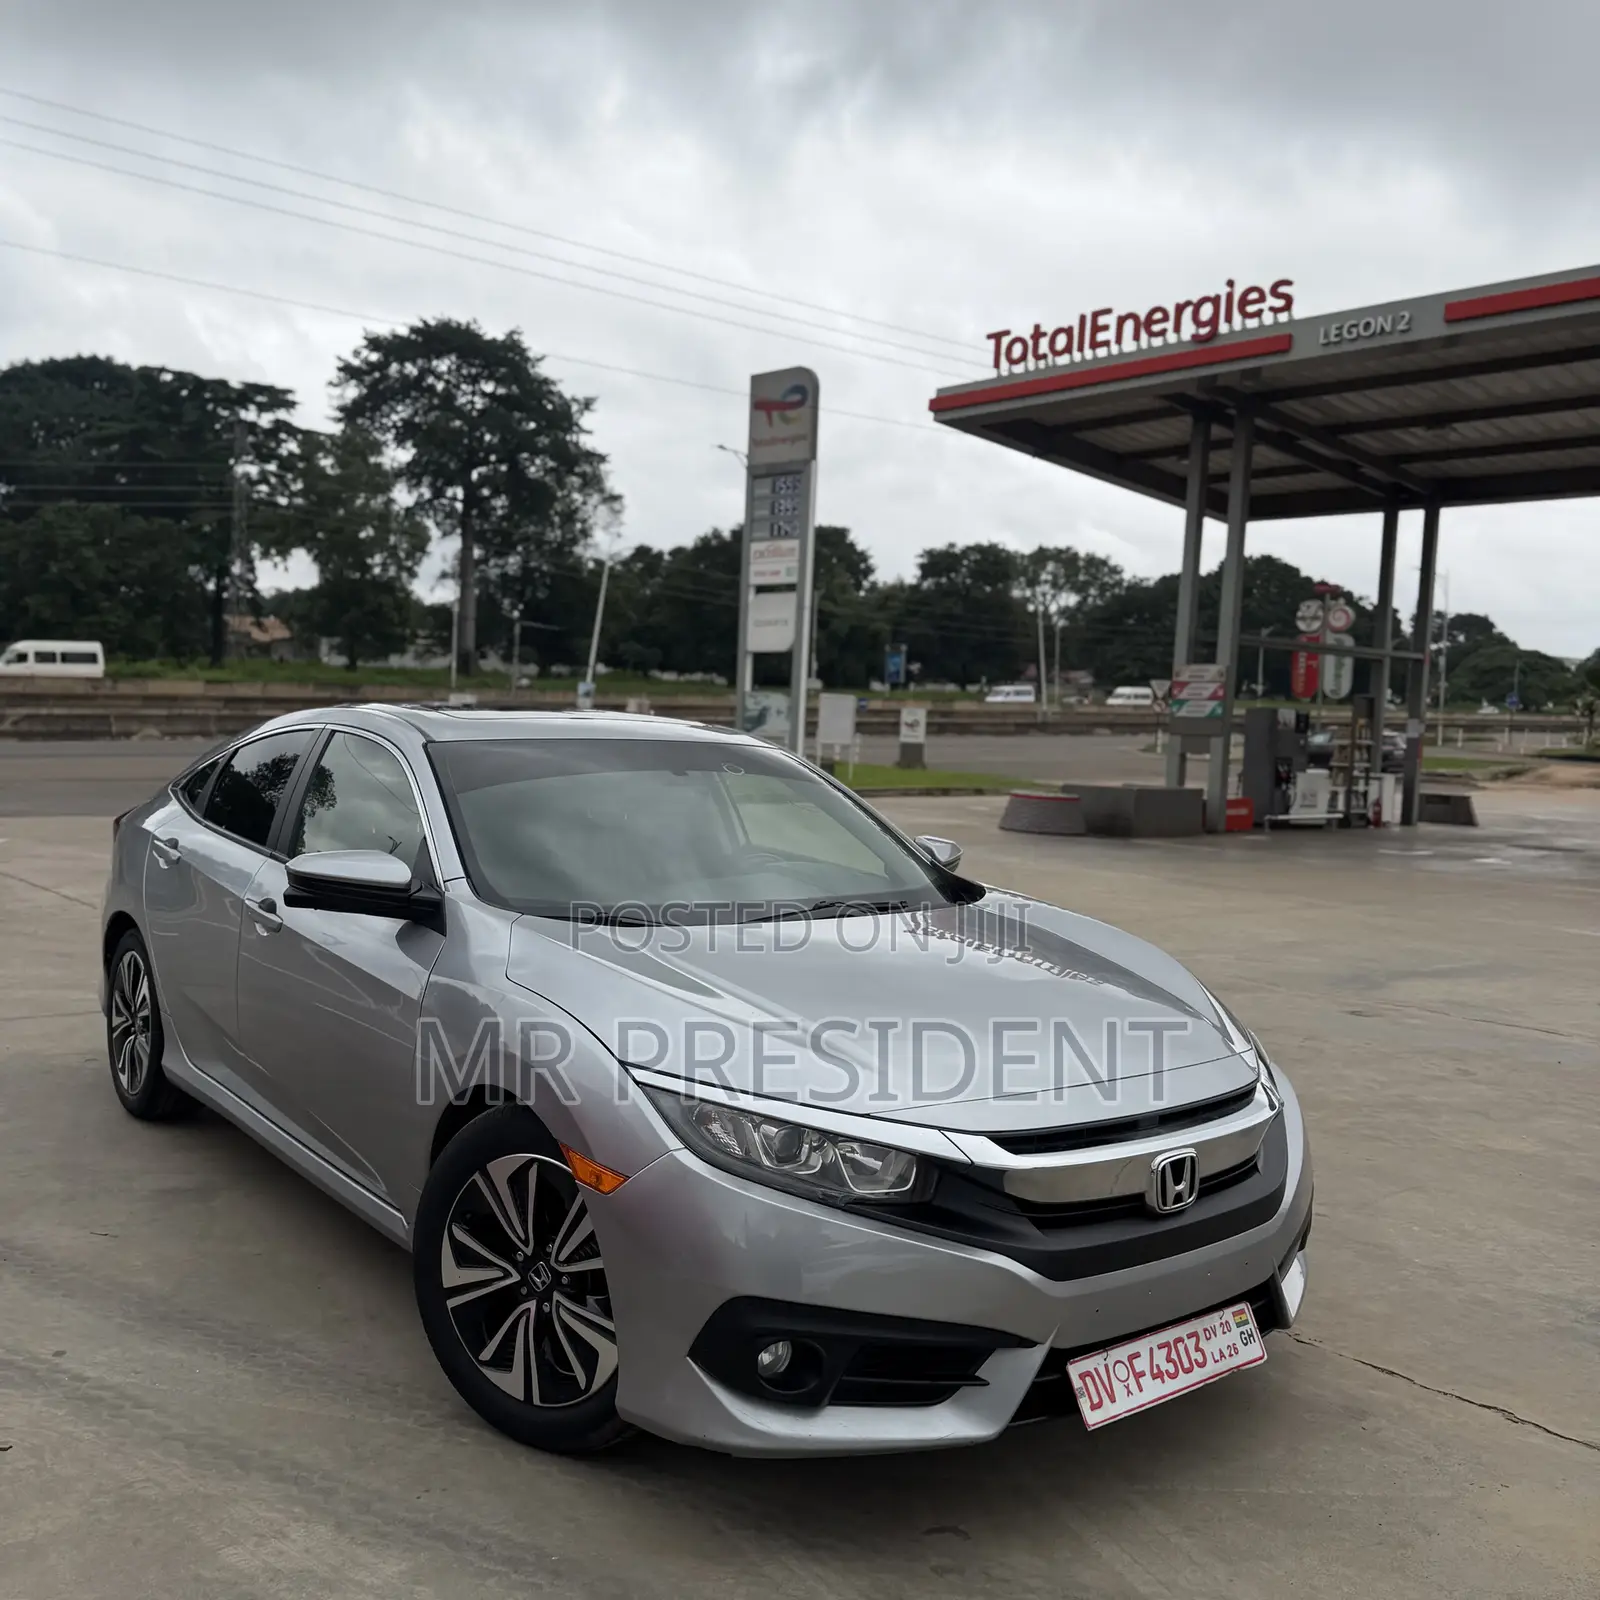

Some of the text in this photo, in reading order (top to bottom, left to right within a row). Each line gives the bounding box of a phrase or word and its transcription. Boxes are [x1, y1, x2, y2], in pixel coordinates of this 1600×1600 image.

[986, 278, 1294, 370] TotalEnergies
[1318, 311, 1411, 346] LEGON 2
[1203, 1319, 1232, 1341] DV 20
[1239, 1327, 1256, 1347] GH
[1211, 1342, 1239, 1364] LA 26
[1078, 1330, 1208, 1412] DV F4303
